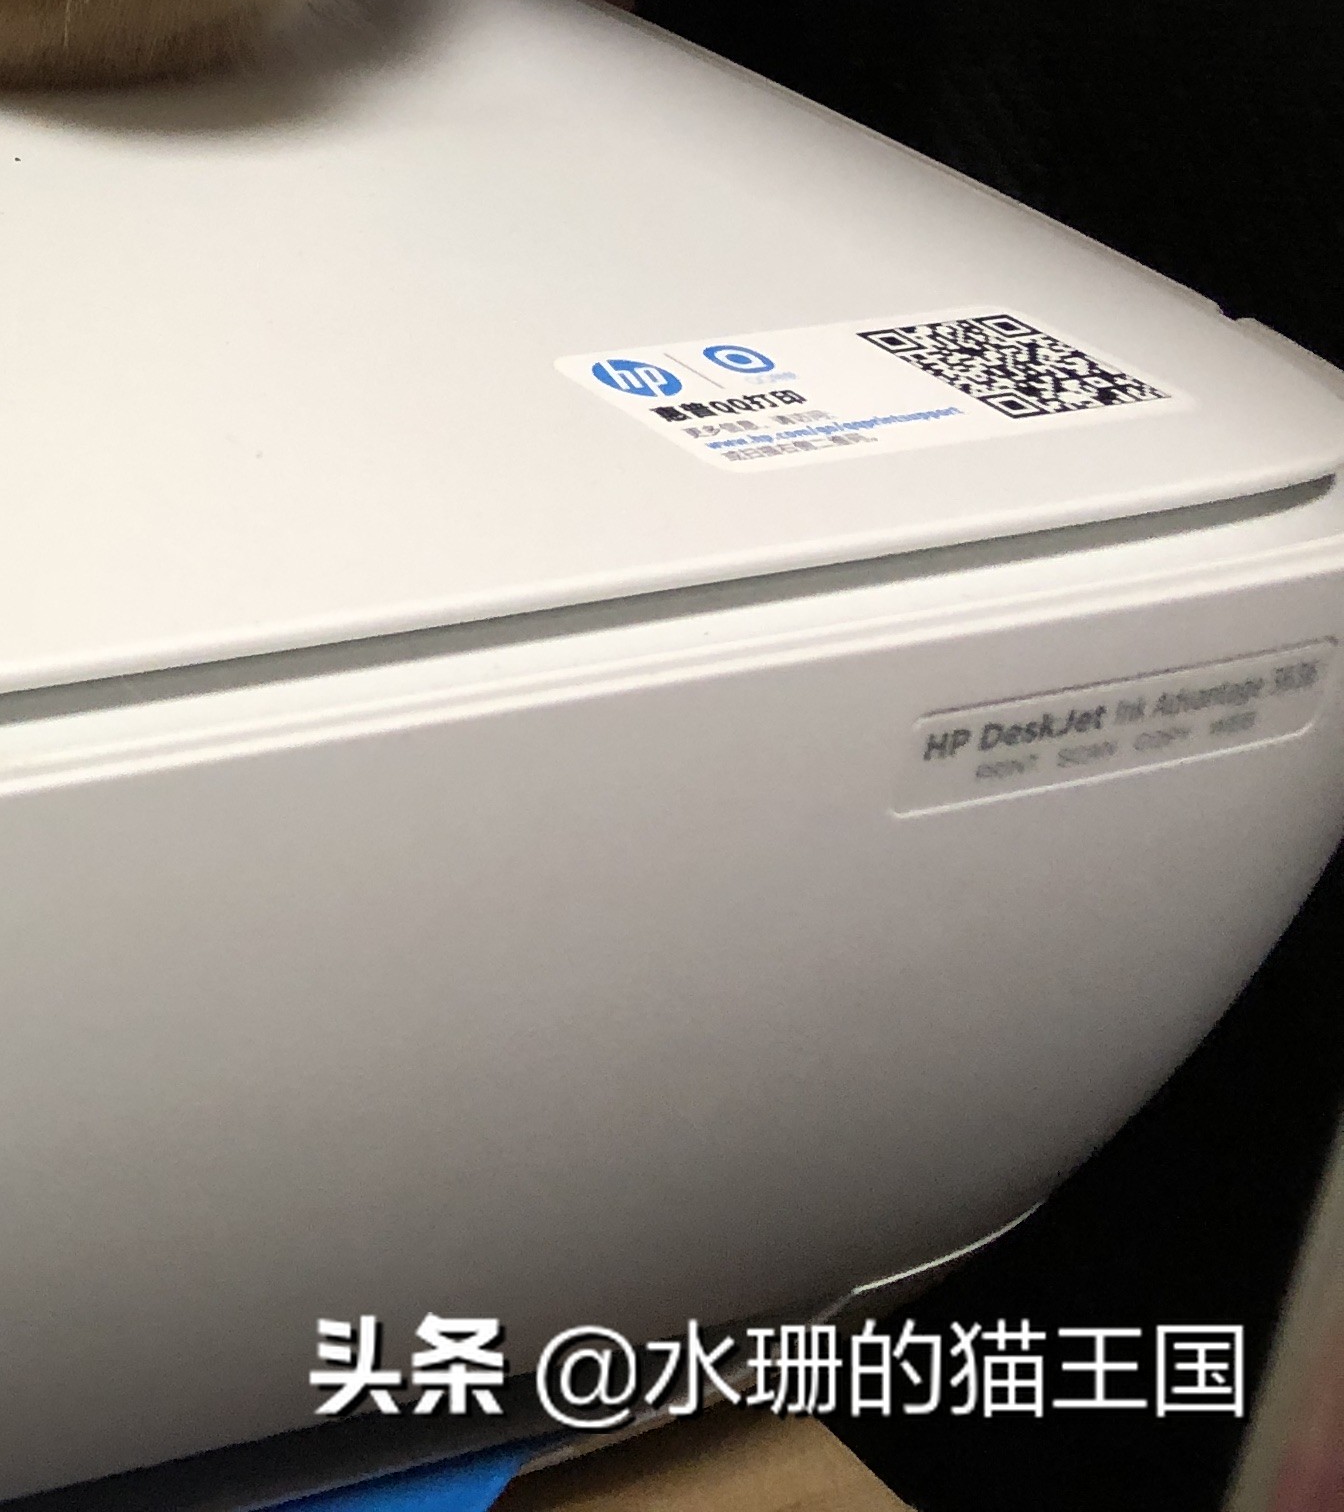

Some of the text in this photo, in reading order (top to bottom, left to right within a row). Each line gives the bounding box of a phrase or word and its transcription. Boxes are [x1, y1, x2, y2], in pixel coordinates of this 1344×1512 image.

[595, 359, 670, 397] hp
[649, 389, 808, 422] 惠普QQ打印
[923, 729, 971, 760] HP
[978, 705, 1107, 751] DeskJet
